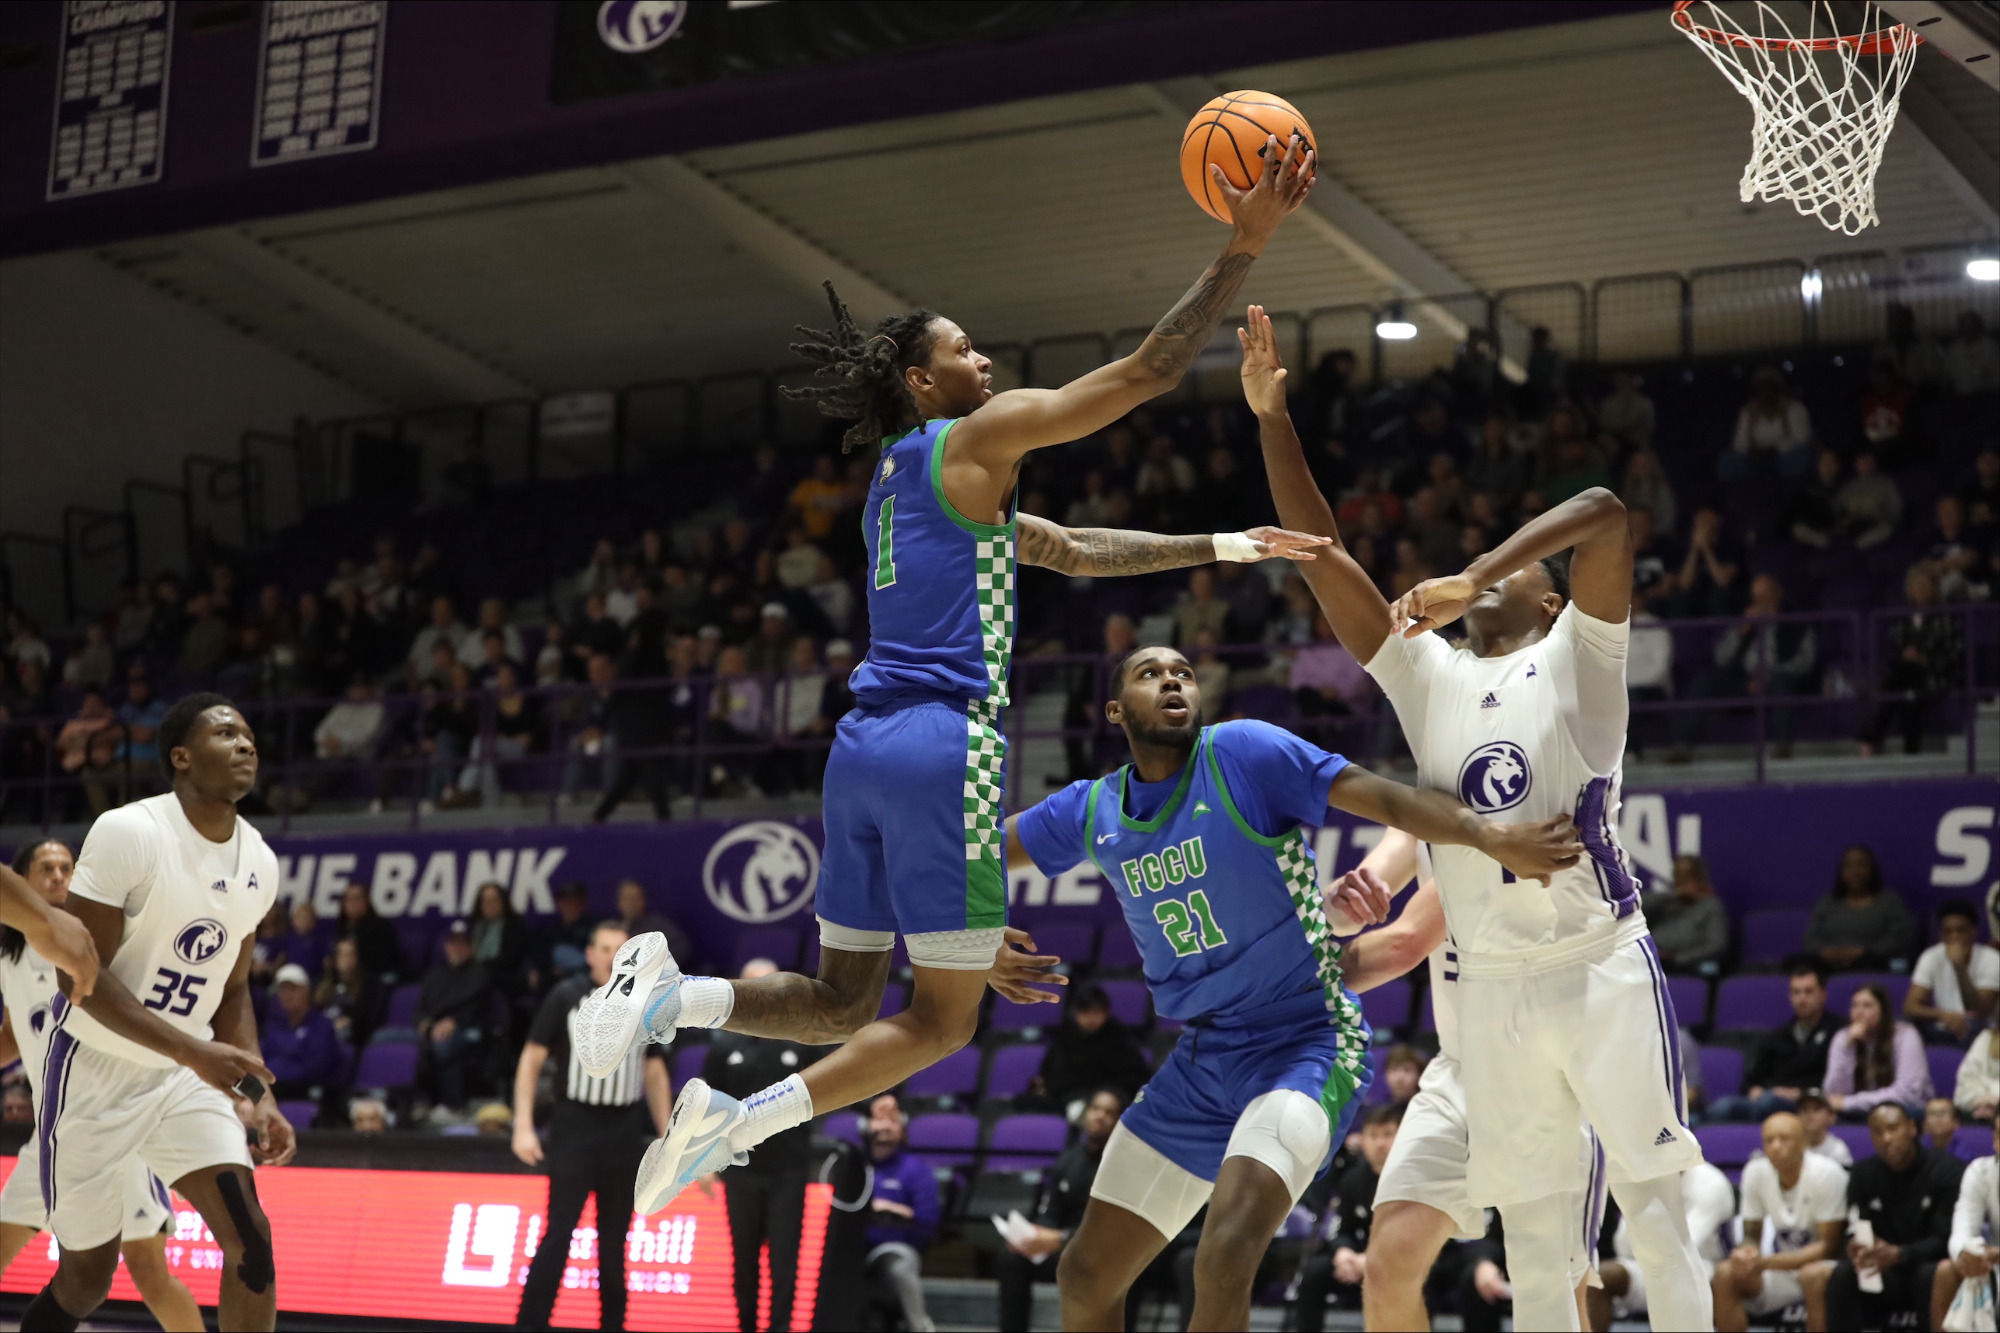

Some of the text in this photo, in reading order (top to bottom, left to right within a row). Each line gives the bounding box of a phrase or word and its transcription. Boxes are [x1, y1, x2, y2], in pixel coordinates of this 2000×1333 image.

[874, 494, 897, 591] 1
[277, 847, 568, 918] HE BANK
[1120, 835, 1207, 897] FGCU
[1153, 889, 1228, 957] 21
[143, 967, 207, 1017] 35
